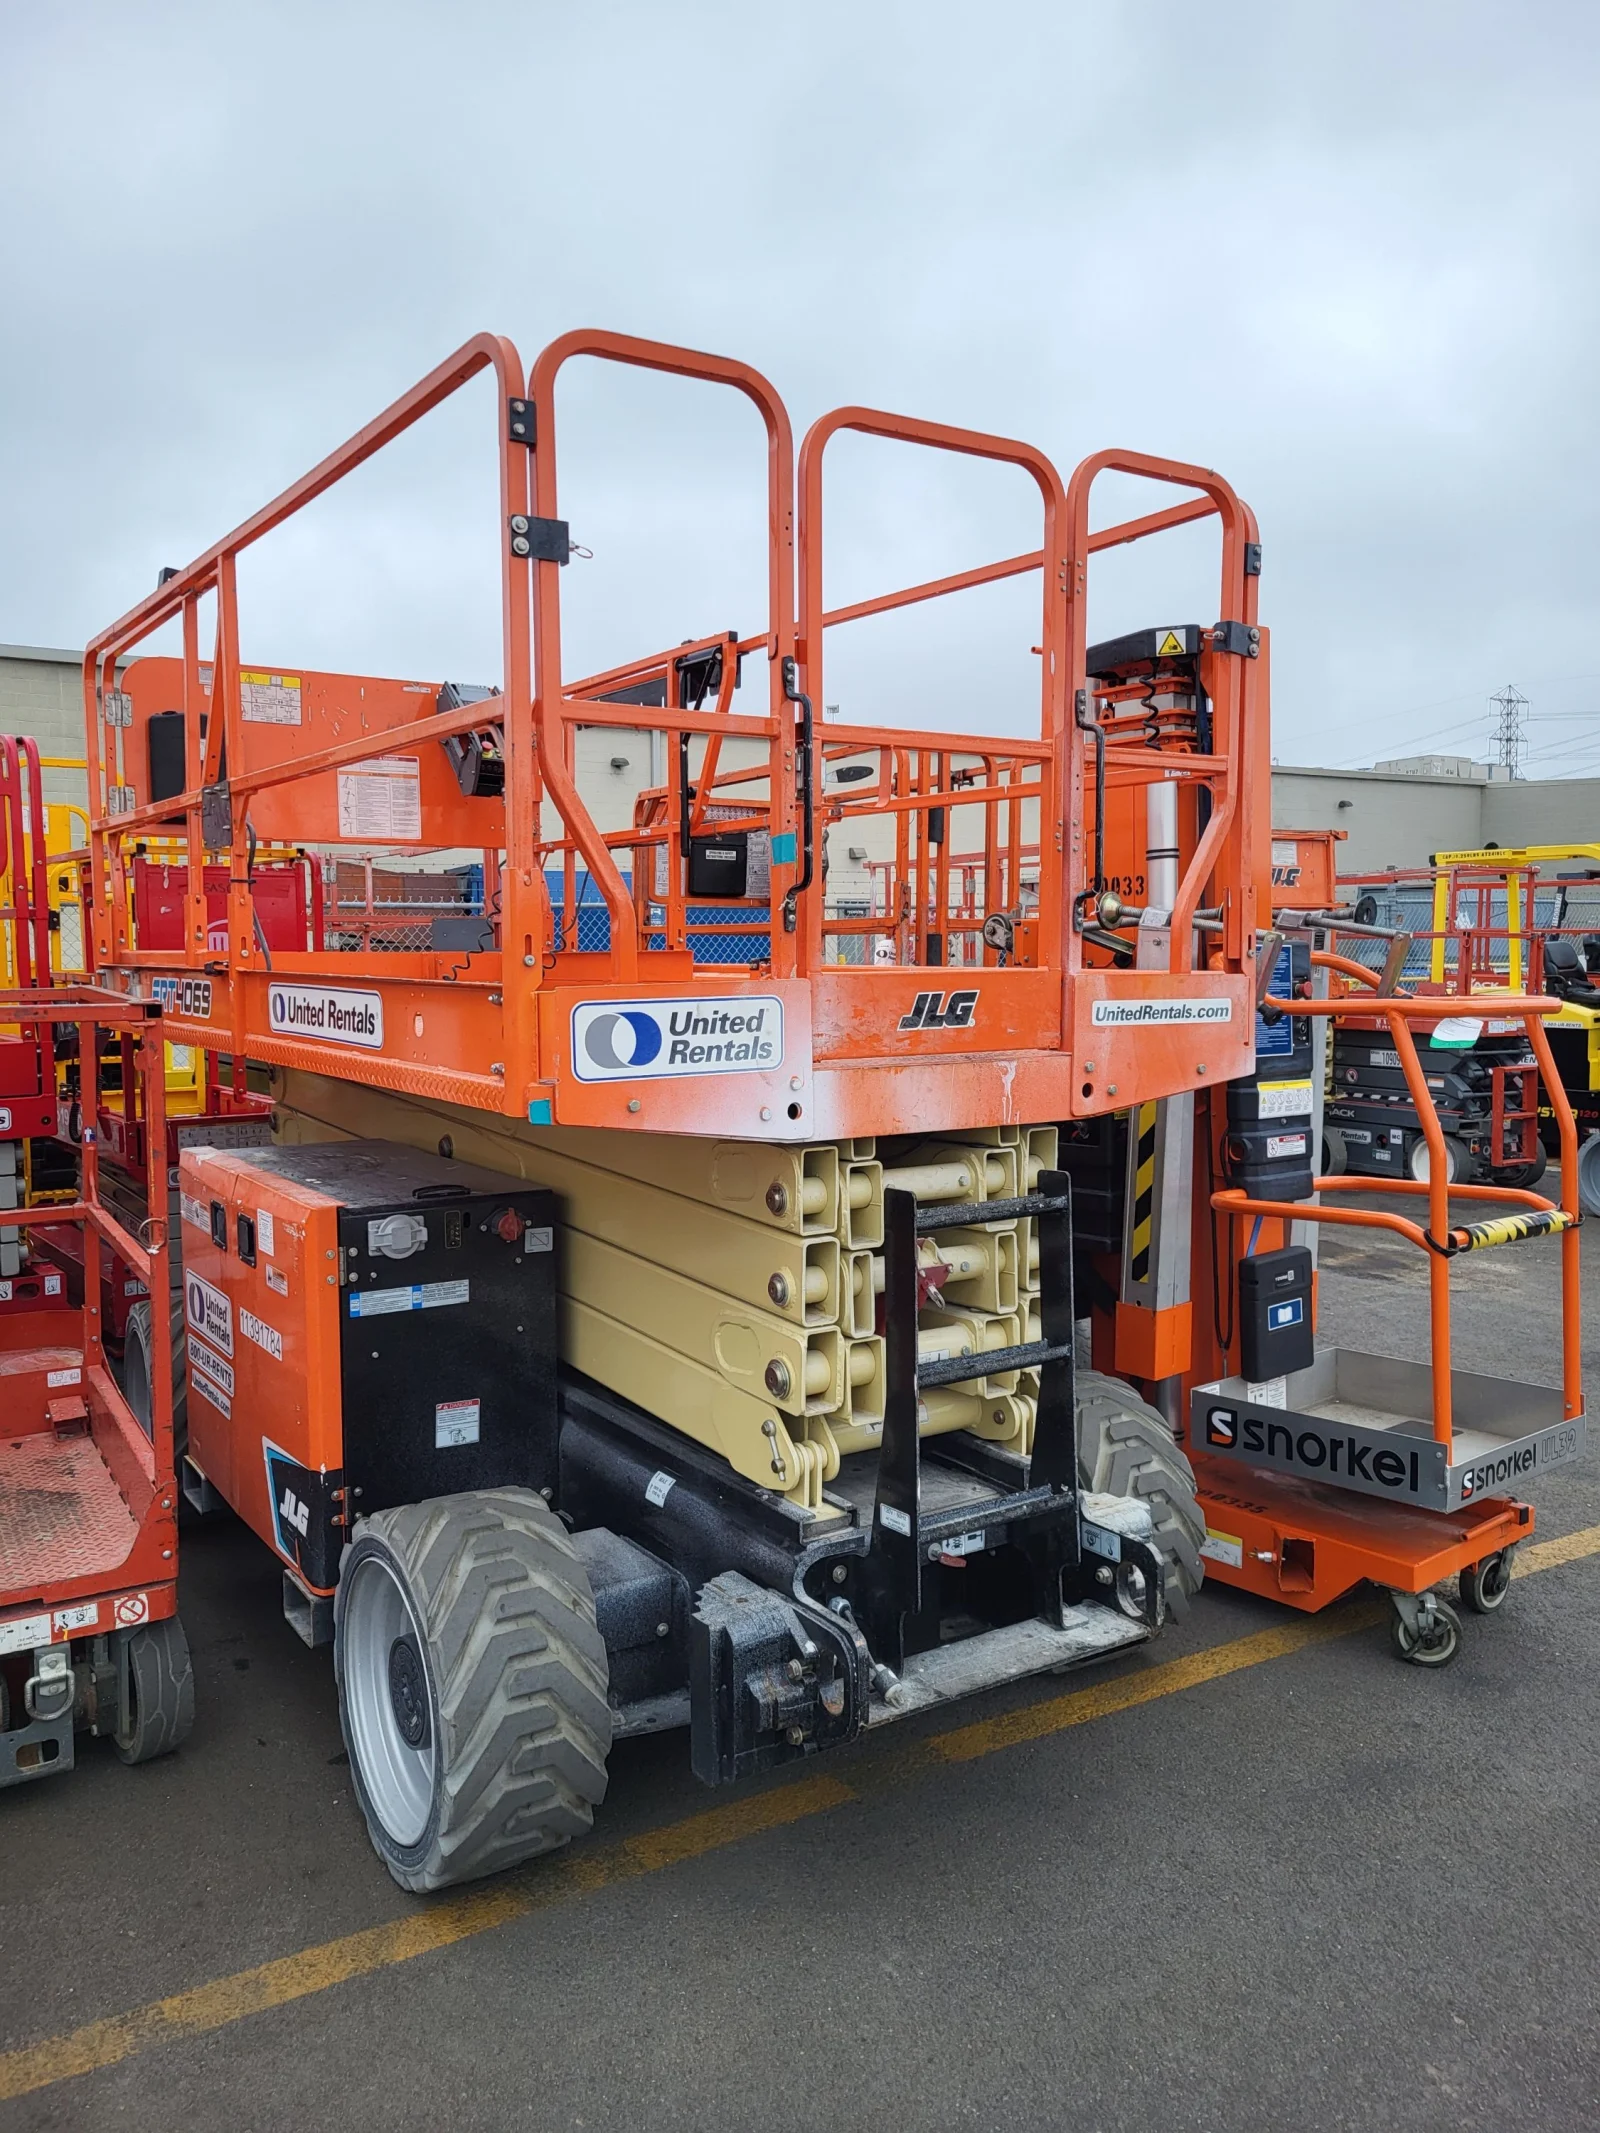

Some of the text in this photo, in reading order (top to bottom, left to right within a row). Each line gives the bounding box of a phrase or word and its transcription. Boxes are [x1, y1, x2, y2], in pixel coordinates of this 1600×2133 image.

[288, 996, 376, 1035] United Rentals
[669, 1008, 765, 1036] United
[897, 990, 980, 1031] JLG
[1095, 1004, 1229, 1021] UnitedRentals.com
[668, 1036, 773, 1065] Rentals
[1341, 1130, 1368, 1141] Rentals
[205, 1292, 228, 1324] United
[206, 1313, 231, 1347] Rentals
[241, 1312, 281, 1359] 11391784
[190, 1341, 232, 1389] 800-UR-RENTS
[192, 1372, 230, 1415] UnitedRentals.com
[1243, 1418, 1419, 1492] snorkel
[1476, 1428, 1577, 1491] snorkel UL32
[279, 1487, 310, 1537] JLG
